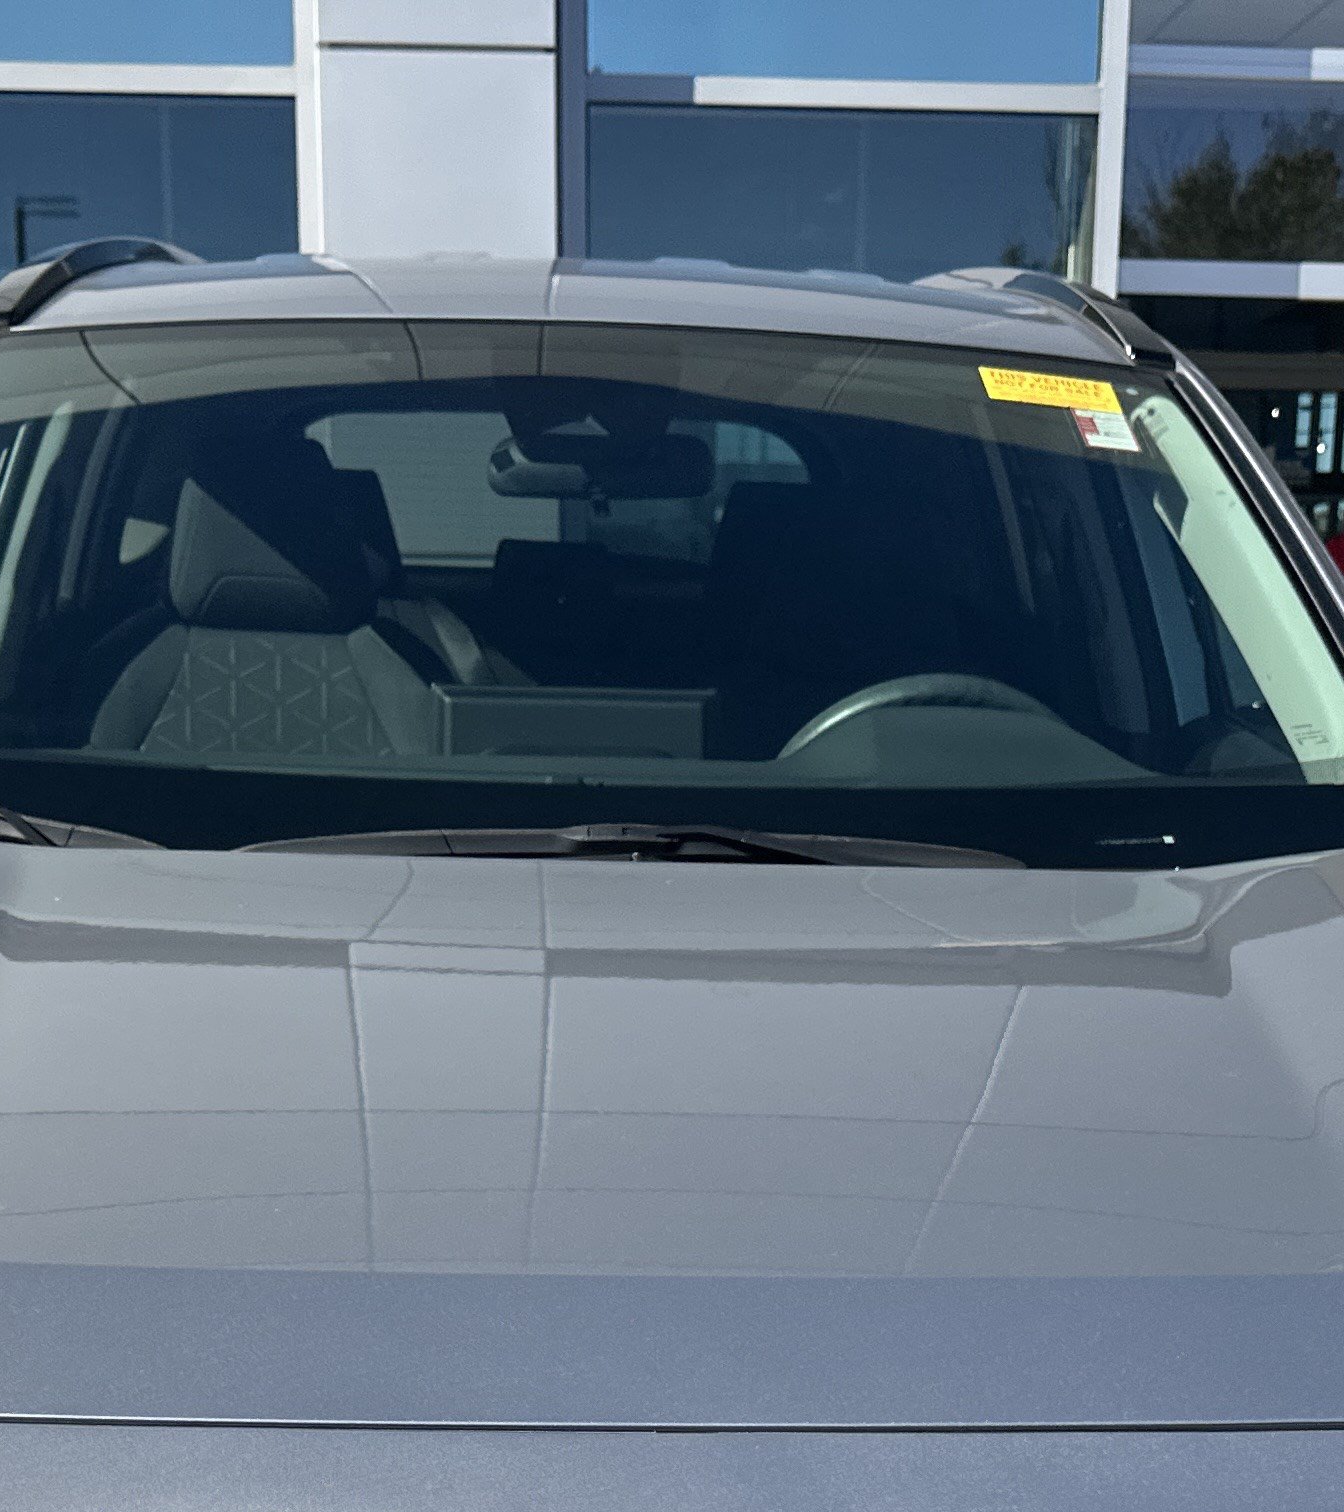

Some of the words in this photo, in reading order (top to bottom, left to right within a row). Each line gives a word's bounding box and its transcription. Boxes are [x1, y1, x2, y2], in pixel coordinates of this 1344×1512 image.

[990, 371, 1027, 381] THIS
[1033, 376, 1102, 390] VEHICLE
[994, 379, 1024, 388] NOT
[1029, 383, 1059, 393] FOR
[1064, 387, 1102, 397] SALE
